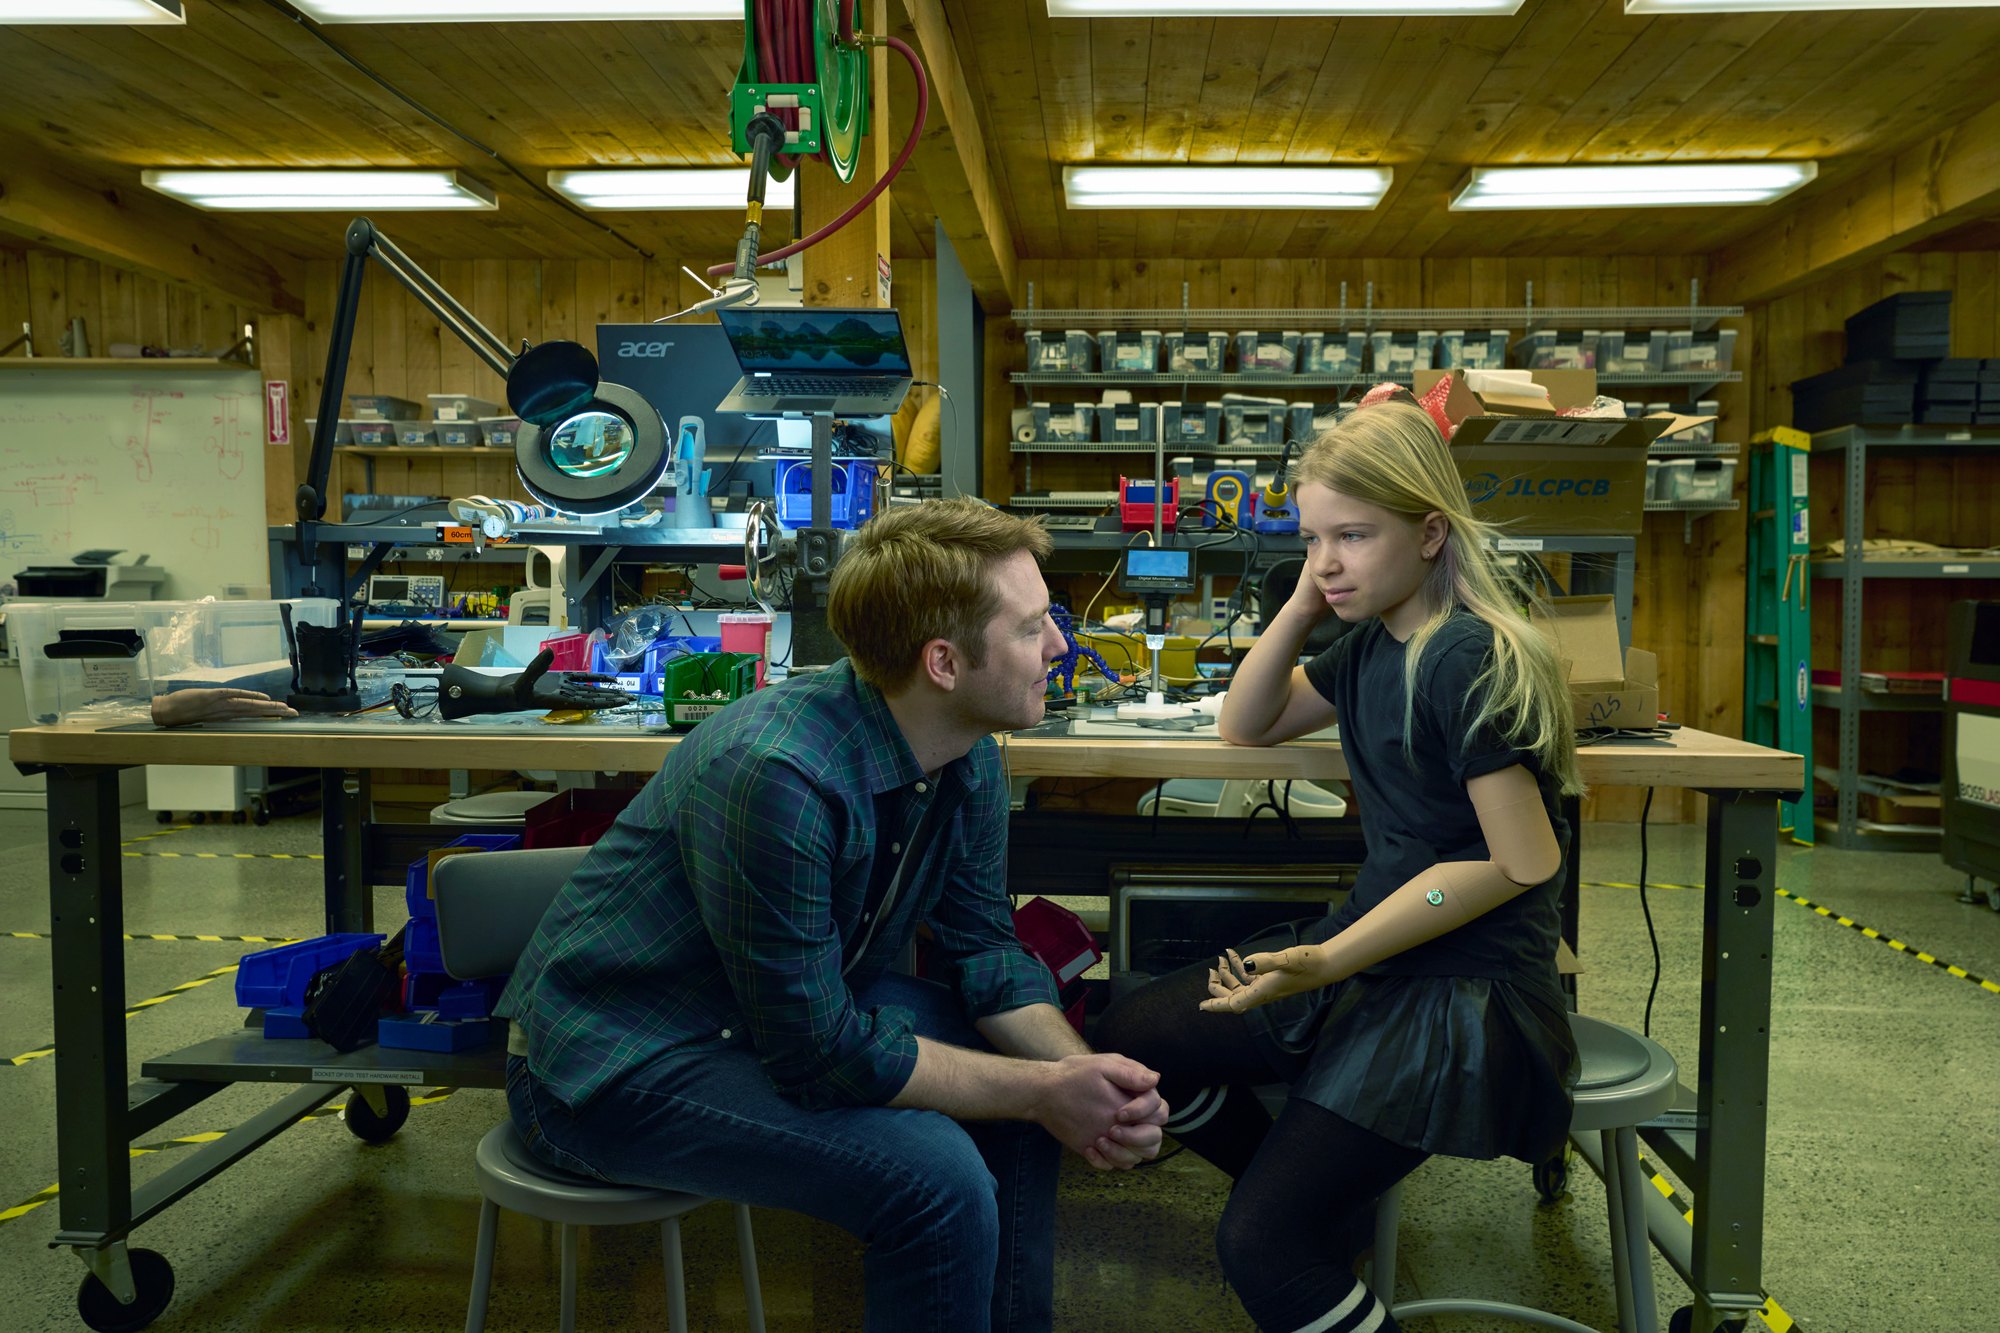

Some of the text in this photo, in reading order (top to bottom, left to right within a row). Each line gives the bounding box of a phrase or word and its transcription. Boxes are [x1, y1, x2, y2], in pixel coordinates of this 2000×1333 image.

[617, 342, 675, 358] acer
[1506, 479, 1611, 497] JLCPCB
[451, 531, 472, 539] 60cm
[356, 1072, 370, 1080] TEST
